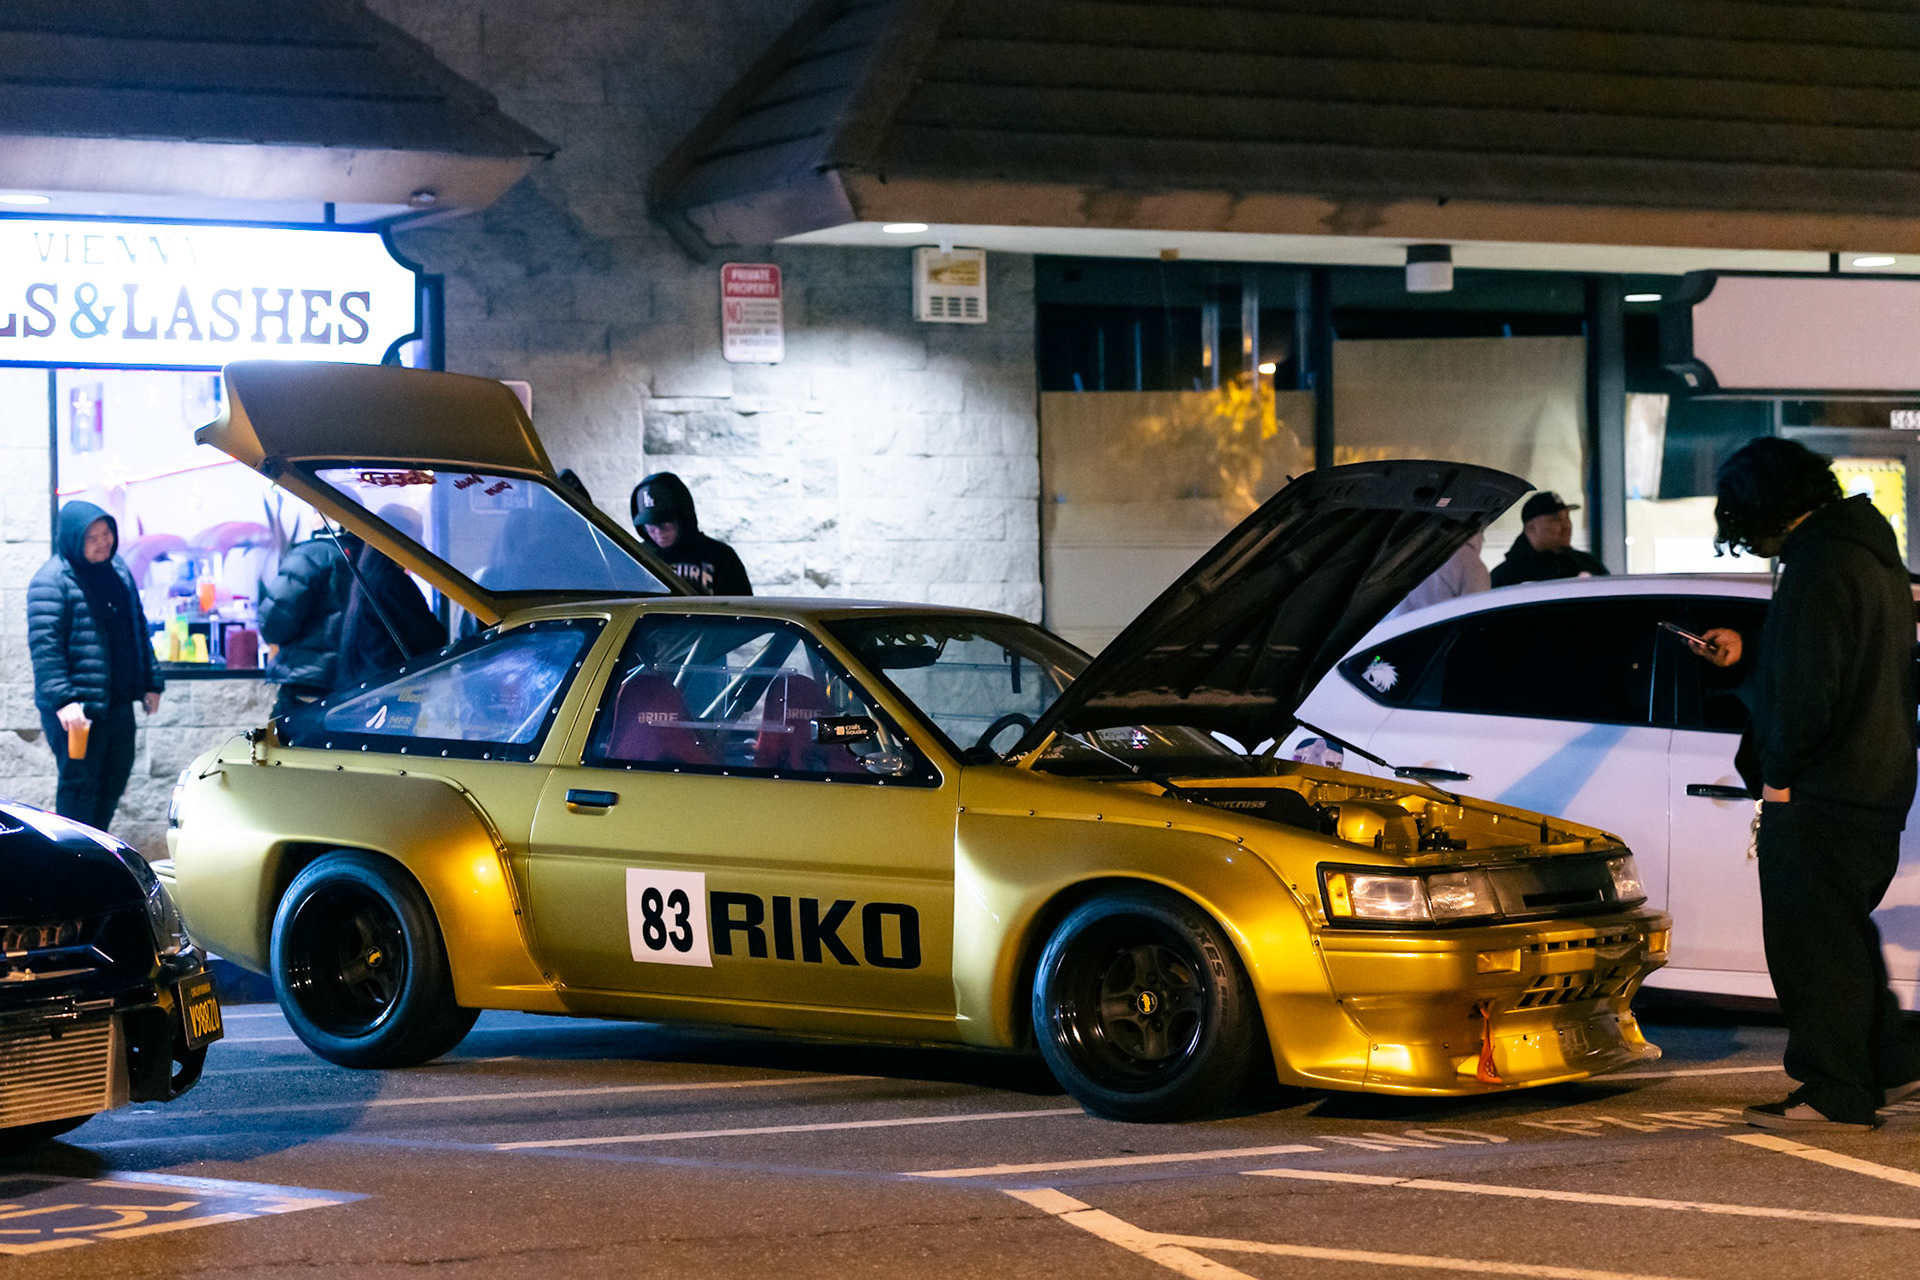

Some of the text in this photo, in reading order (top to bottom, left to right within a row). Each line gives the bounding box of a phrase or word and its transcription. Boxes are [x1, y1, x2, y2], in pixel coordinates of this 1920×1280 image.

[637, 711, 679, 723] BRIDE
[641, 886, 922, 970] 83 RIKO
